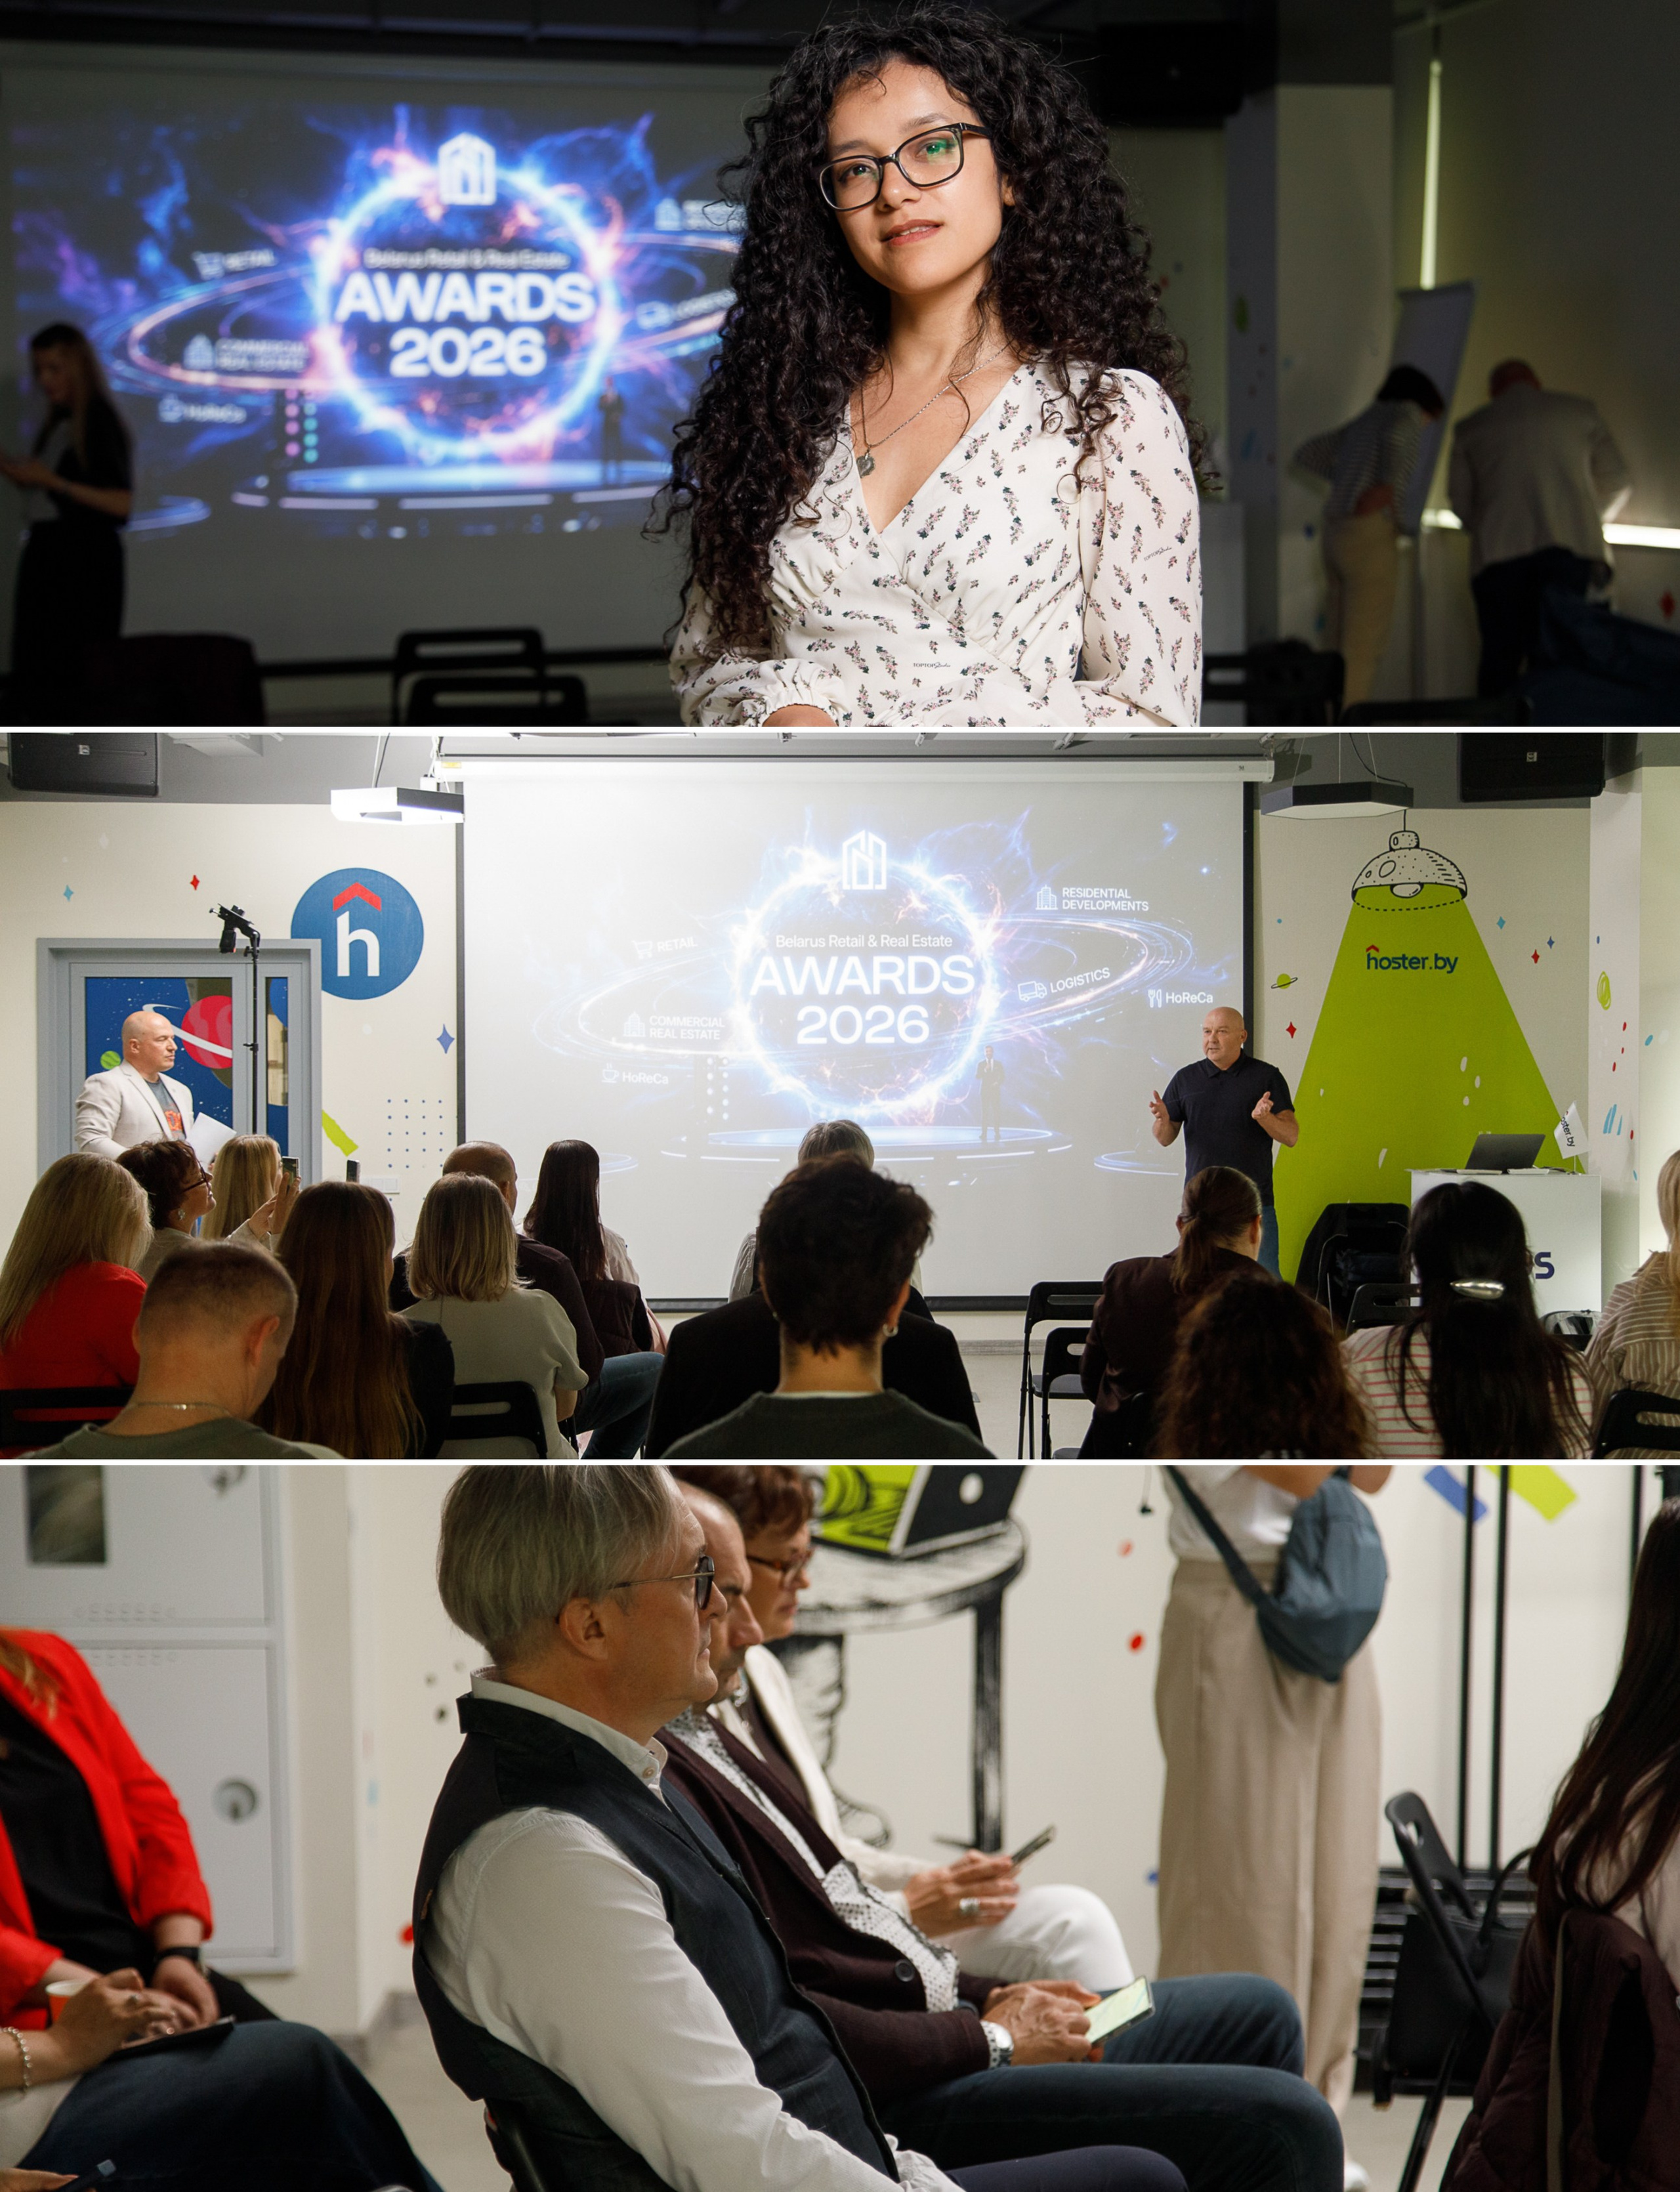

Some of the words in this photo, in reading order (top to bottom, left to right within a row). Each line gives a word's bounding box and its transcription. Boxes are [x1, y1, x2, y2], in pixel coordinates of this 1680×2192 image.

[335, 272, 595, 322] AWARDS
[390, 327, 547, 377] 2026
[1062, 887, 1131, 899] RESIDENTIAL
[1062, 900, 1149, 912] DEVELOPMENTS
[657, 937, 698, 952] RETAIL
[776, 935, 826, 948] Belarus
[829, 935, 864, 947] Retail
[868, 935, 877, 947] &
[881, 935, 910, 947] Real
[912, 934, 953, 947] Estate
[1366, 952, 1459, 975] hoster.by
[749, 954, 975, 996] AWARDS
[1050, 967, 1110, 993] LOGISTICS
[1166, 992, 1213, 1003] HoReCa
[649, 1015, 725, 1028] COMMERCIAL
[797, 1004, 930, 1044] 2026
[650, 1029, 677, 1039] REAL
[681, 1029, 721, 1040] ESTATE
[622, 1072, 669, 1085] HoReCa
[1561, 1116, 1576, 1147] oster.by
